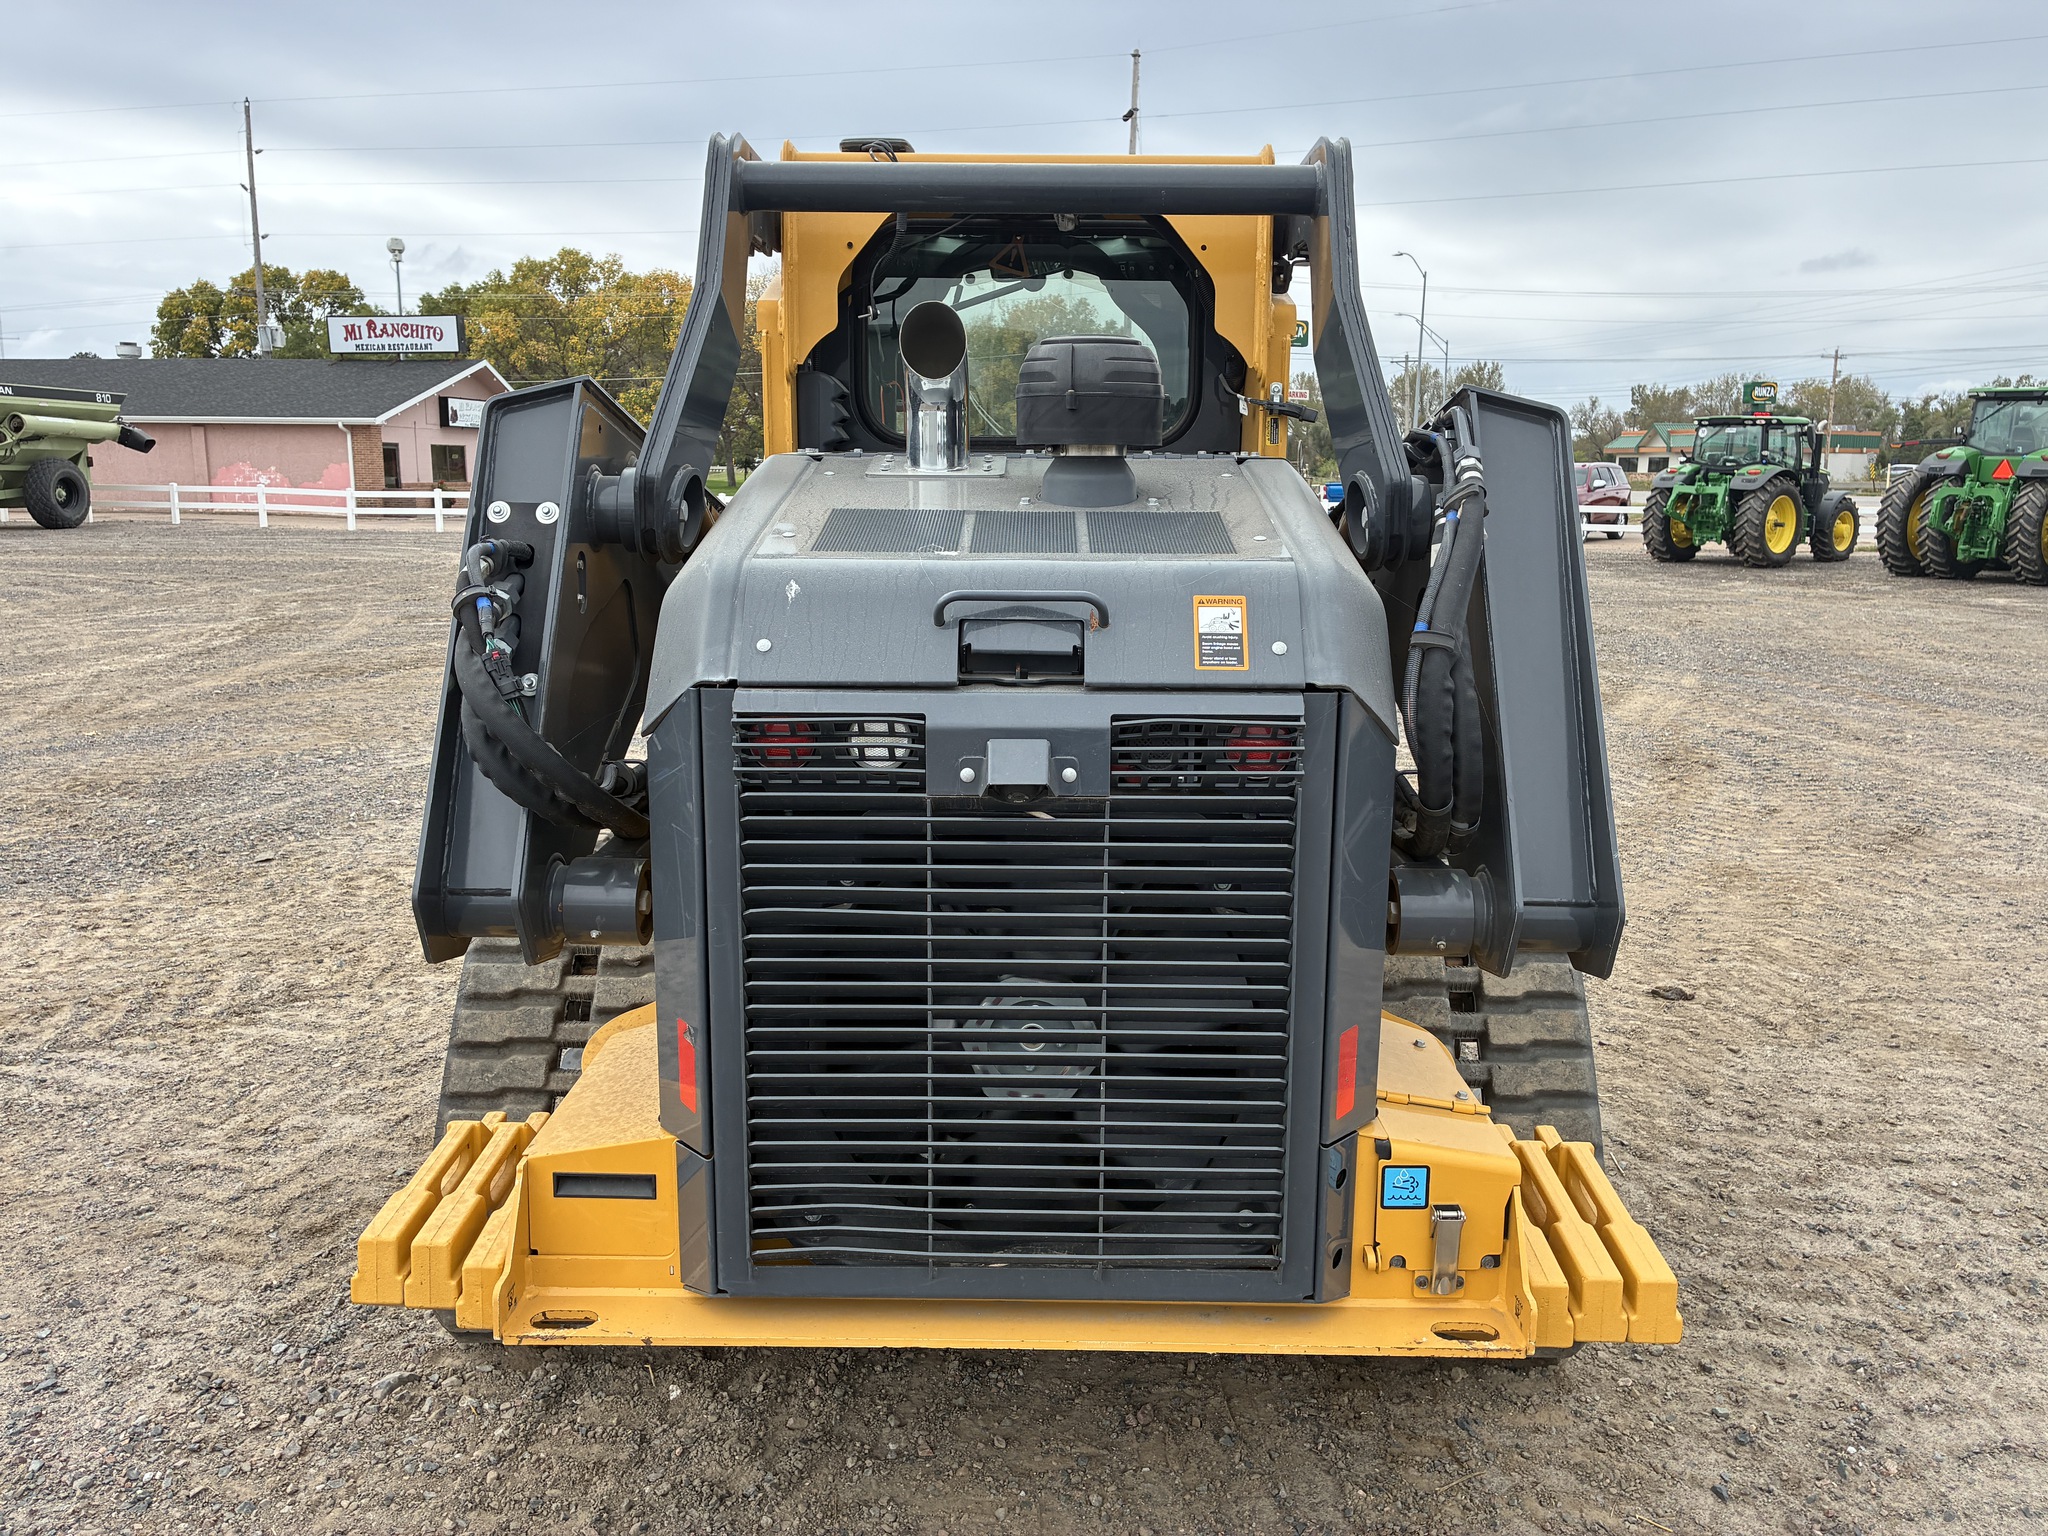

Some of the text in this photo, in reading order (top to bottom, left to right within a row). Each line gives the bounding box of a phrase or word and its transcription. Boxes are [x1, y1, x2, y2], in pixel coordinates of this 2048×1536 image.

[366, 319, 444, 342] RANCHITO
[355, 342, 433, 351] MEXICAN RESTAURANT
[1754, 386, 1775, 397] RUNZA
[95, 393, 111, 403] 810
